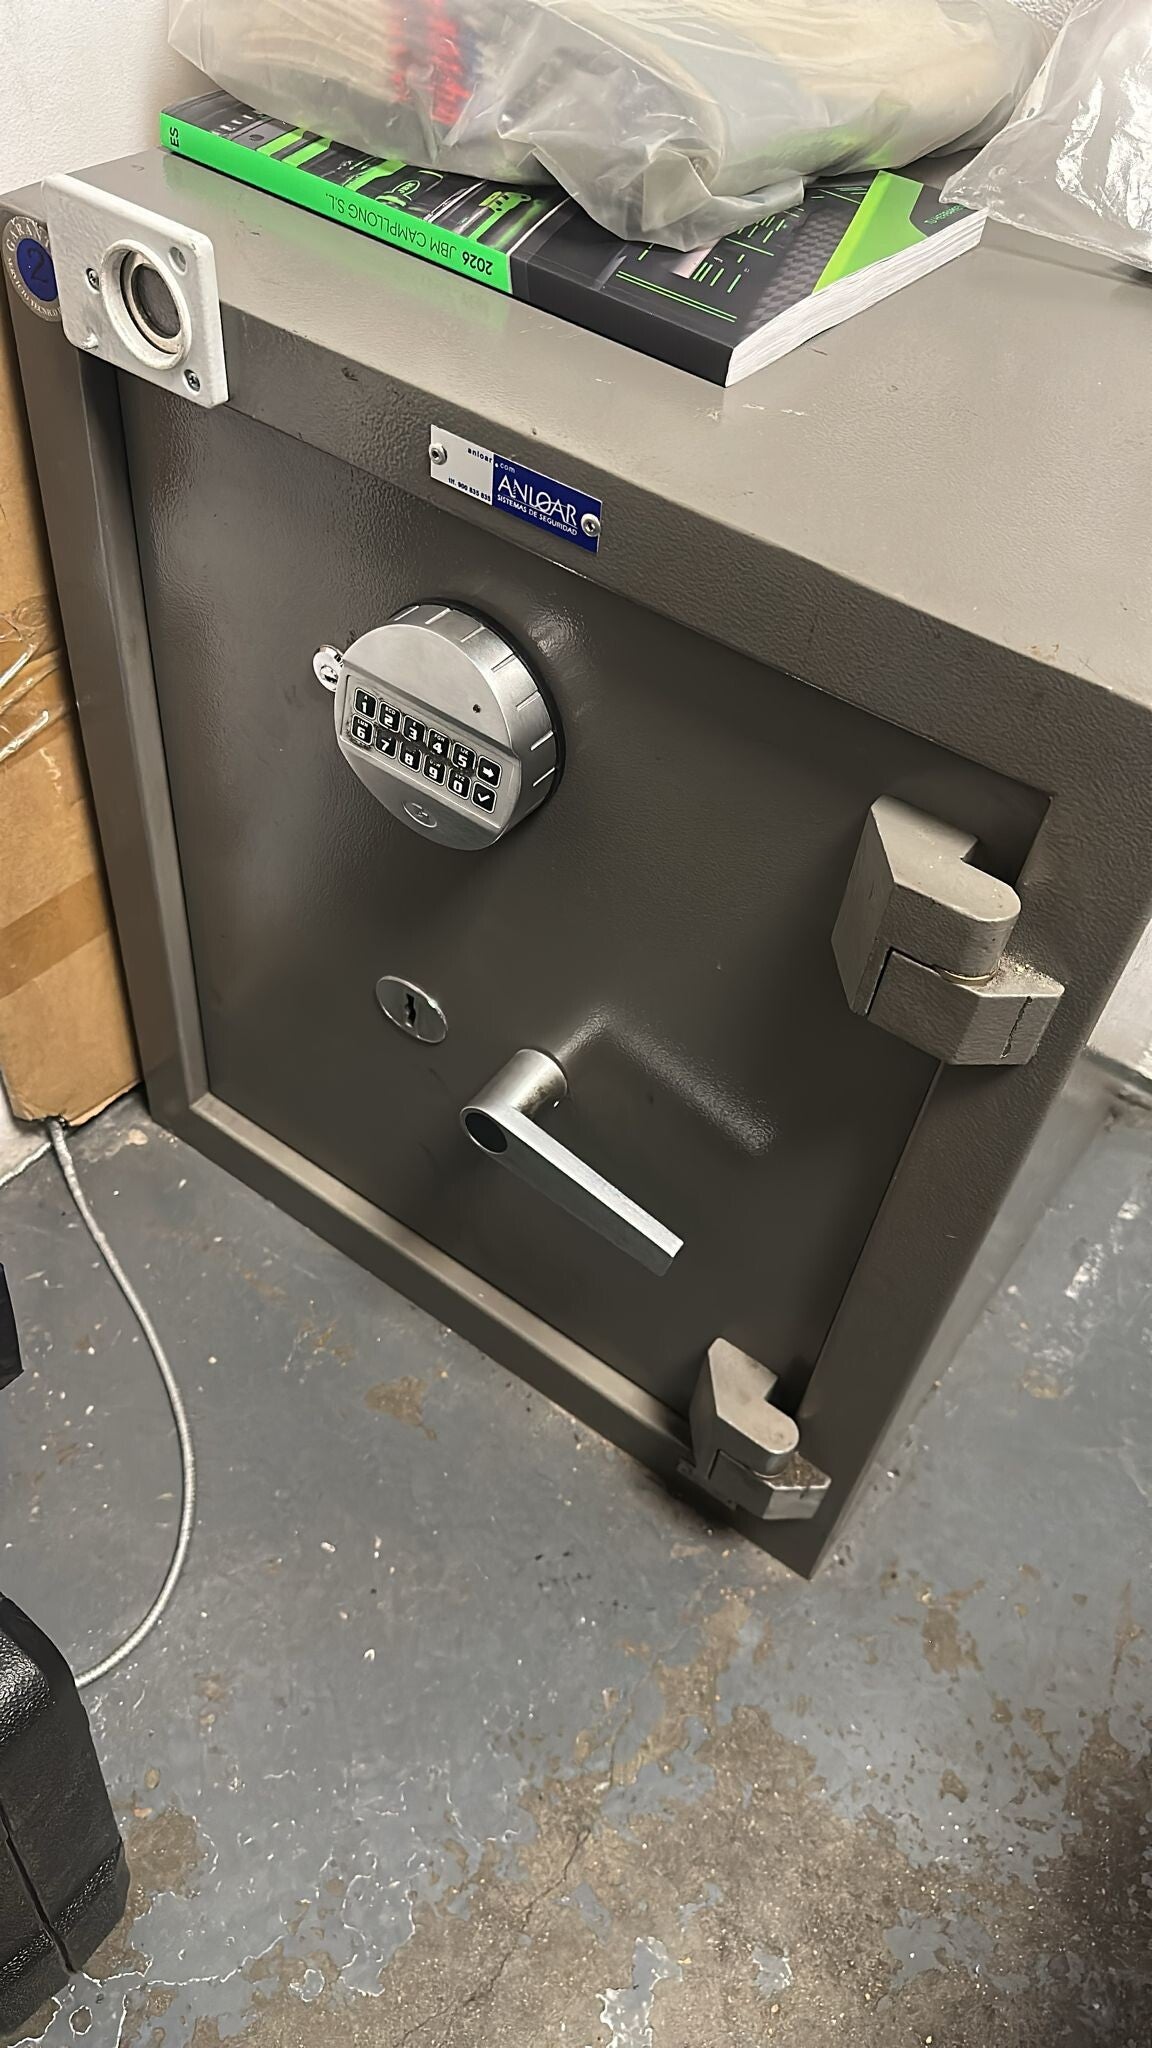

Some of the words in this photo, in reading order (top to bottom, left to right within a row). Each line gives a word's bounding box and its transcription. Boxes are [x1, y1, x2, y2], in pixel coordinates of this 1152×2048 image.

[169, 126, 180, 148] ES
[325, 193, 345, 214] S.L.
[348, 203, 427, 248] CAMPLLONG
[429, 241, 457, 259] JBM
[461, 251, 494, 276] 2026
[496, 494, 527, 513] SISTEMAS
[528, 508, 538, 518] DE
[539, 513, 578, 536] SEGURIDAD
[362, 702, 367, 713] 1
[384, 713, 394, 728] 2
[408, 726, 418, 741] 3
[432, 742, 443, 755] 4
[458, 754, 468, 768] 5
[356, 726, 366, 739] 6
[380, 739, 390, 752] 7
[404, 752, 414, 766] 8
[428, 766, 438, 780] 9
[452, 780, 463, 793] 0
